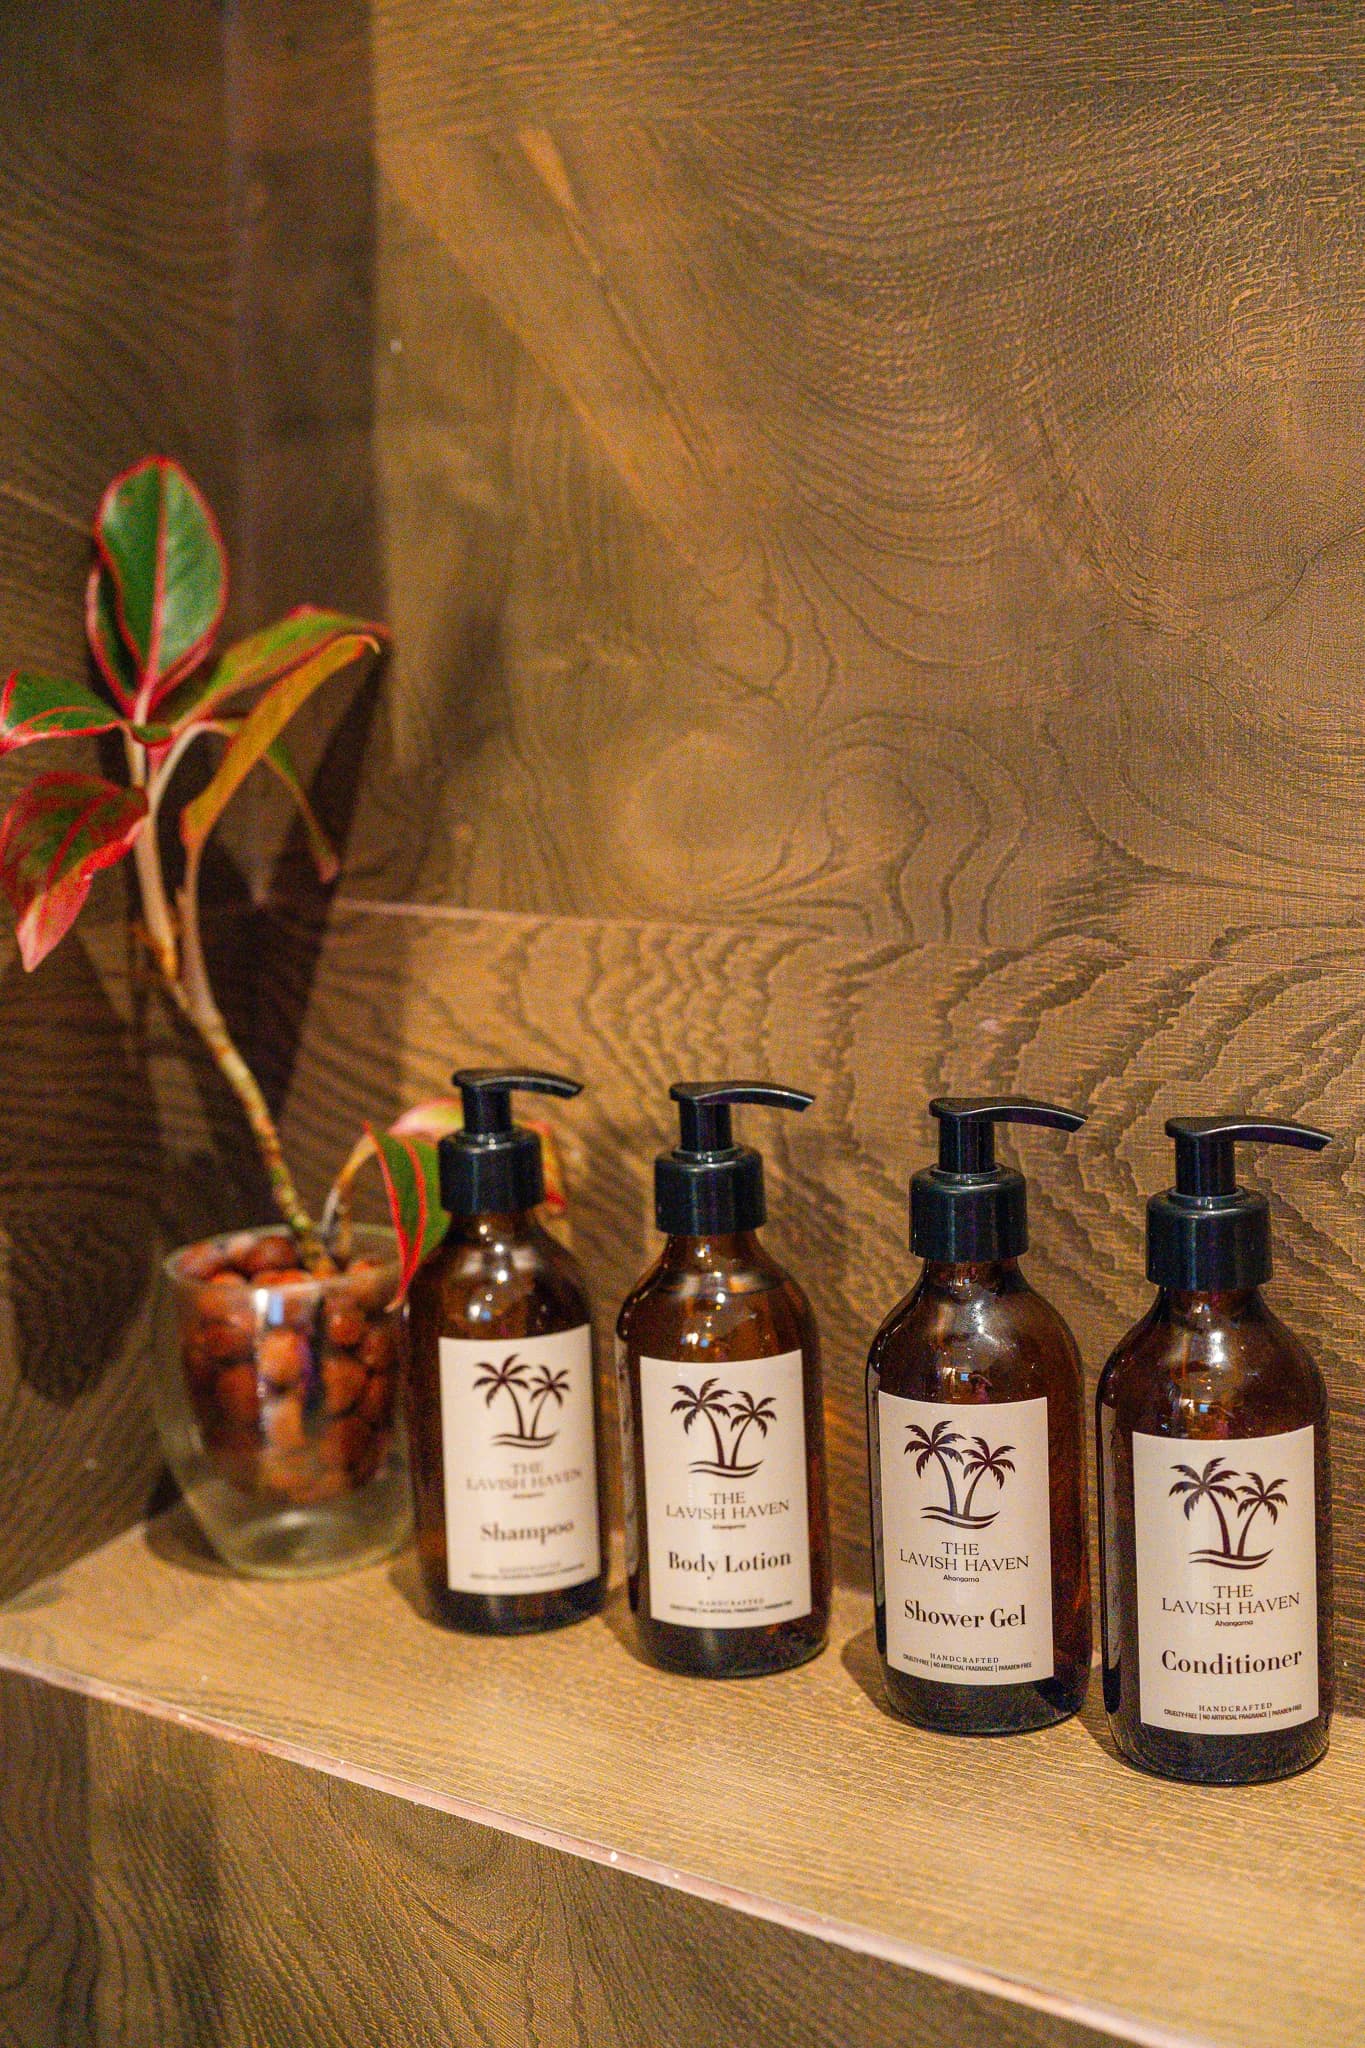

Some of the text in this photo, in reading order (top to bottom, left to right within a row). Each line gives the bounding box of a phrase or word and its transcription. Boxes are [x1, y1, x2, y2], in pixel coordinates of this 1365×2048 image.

[710, 1491, 746, 1505] THE
[666, 1500, 790, 1520] LAVISH HAVEN
[480, 1521, 575, 1546] Shampoo
[941, 1541, 980, 1556] THE
[669, 1551, 792, 1580] Body Lotion
[900, 1548, 1029, 1571] LAVISH HAVEN
[943, 1574, 980, 1583] Ahangama
[1213, 1584, 1254, 1599] THE
[1162, 1592, 1300, 1615] LAVISH HAVEN
[904, 1599, 1026, 1628] Shower Gel
[1215, 1620, 1254, 1628] Ahangama
[930, 1652, 999, 1664] HANDCRAFTED
[1161, 1649, 1302, 1675] Conditioner
[1199, 1702, 1273, 1712] HANDCRAFTED
